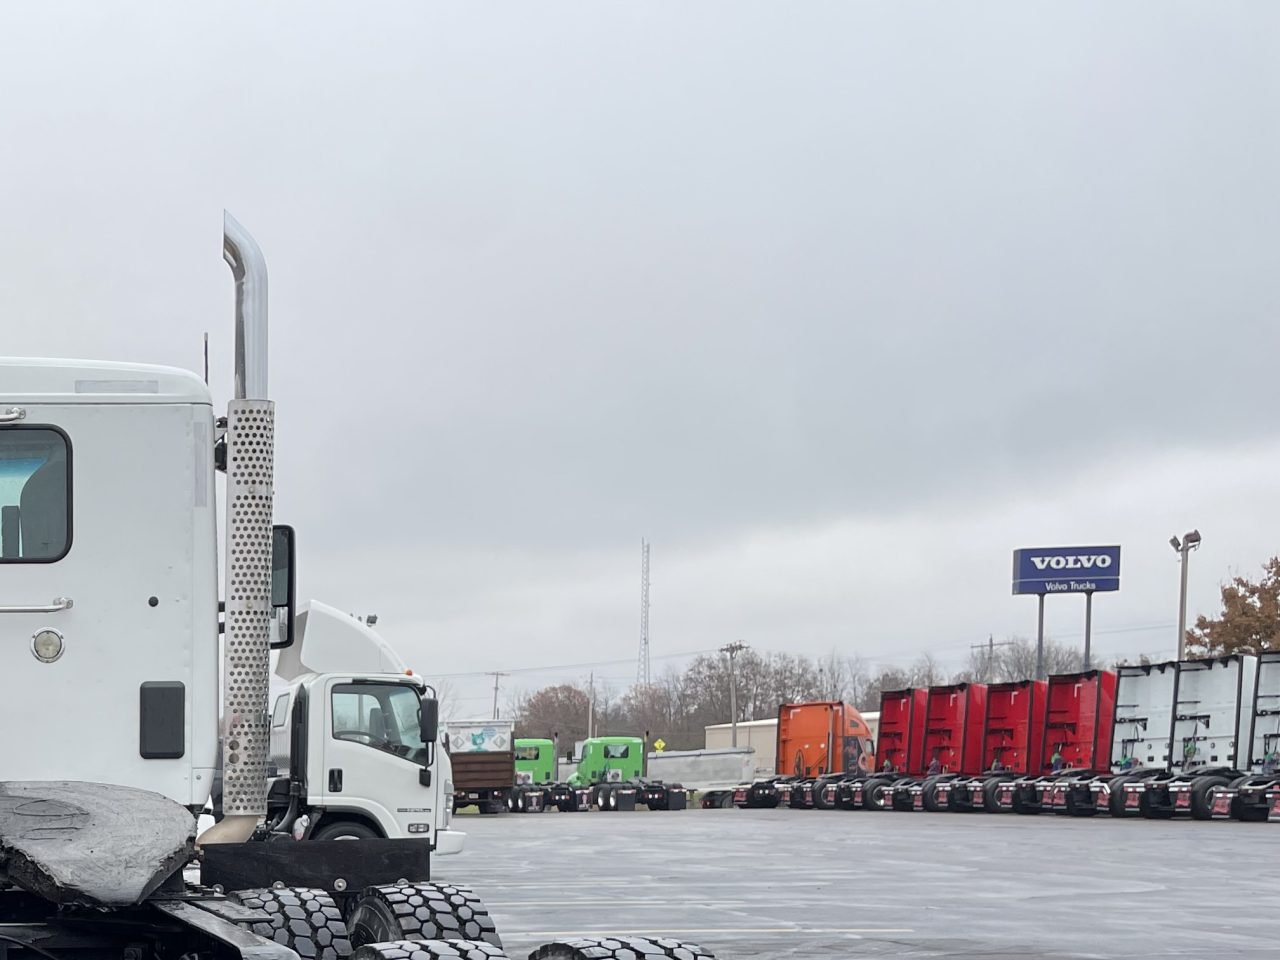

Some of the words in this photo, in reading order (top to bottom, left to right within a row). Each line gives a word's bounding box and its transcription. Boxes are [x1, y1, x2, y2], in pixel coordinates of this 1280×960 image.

[1030, 554, 1112, 569] VOLVO
[1045, 582, 1068, 591] Volvo
[1069, 581, 1096, 590] Trucks
